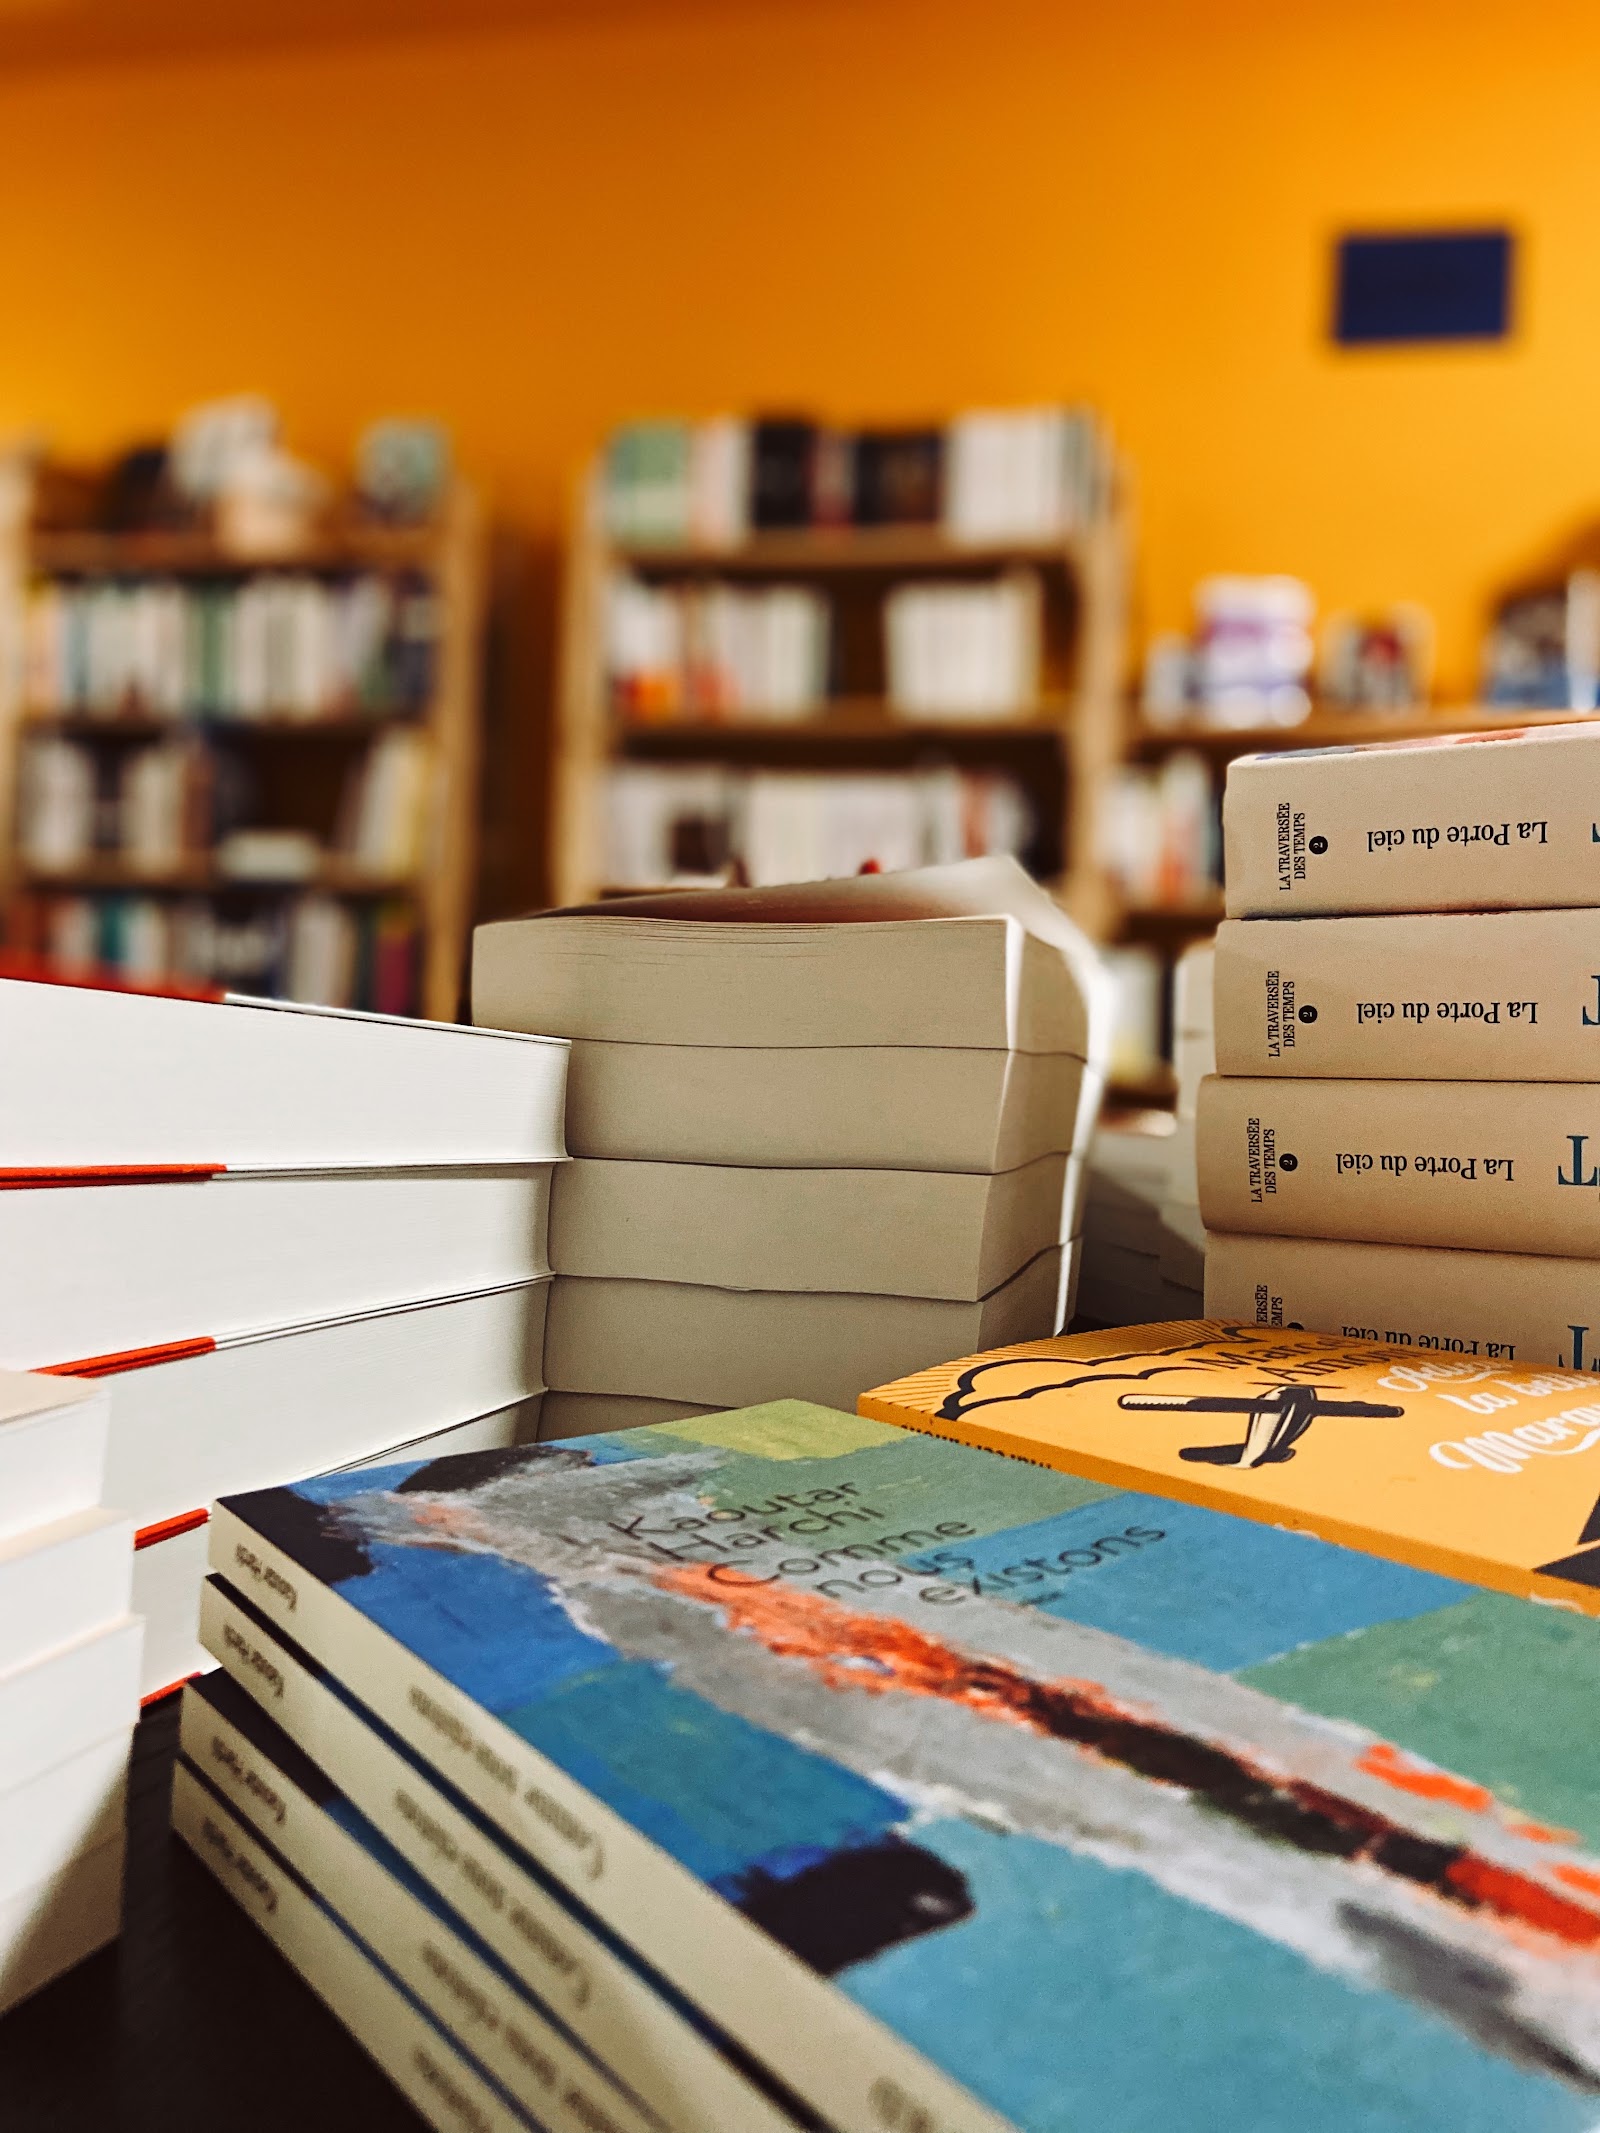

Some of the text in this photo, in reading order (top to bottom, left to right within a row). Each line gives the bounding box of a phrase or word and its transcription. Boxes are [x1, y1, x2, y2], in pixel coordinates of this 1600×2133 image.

[1293, 813, 1305, 879] DES TEMPS
[1366, 822, 1548, 853] La Porte du ciel
[1279, 875, 1291, 890] LA
[1283, 981, 1295, 1047] DES TEMPS
[1356, 1001, 1539, 1025] La Porte du ciel
[1269, 1042, 1280, 1057] LA
[1264, 1129, 1277, 1194] DES TEMPS
[1335, 1153, 1515, 1182] La Porte du ciel
[1557, 1135, 1600, 1187] T
[1251, 1188, 1262, 1203] LA
[1271, 1297, 1282, 1327] EMPS
[1419, 1335, 1479, 1356] Porte
[1486, 1341, 1516, 1360] La
[1558, 1325, 1600, 1372] T
[607, 1481, 861, 1541] Kaoutar
[648, 1500, 886, 1561] Harchi
[706, 1521, 977, 1588] Comme
[814, 1552, 975, 1599] nous
[918, 1525, 1167, 1605] existons
